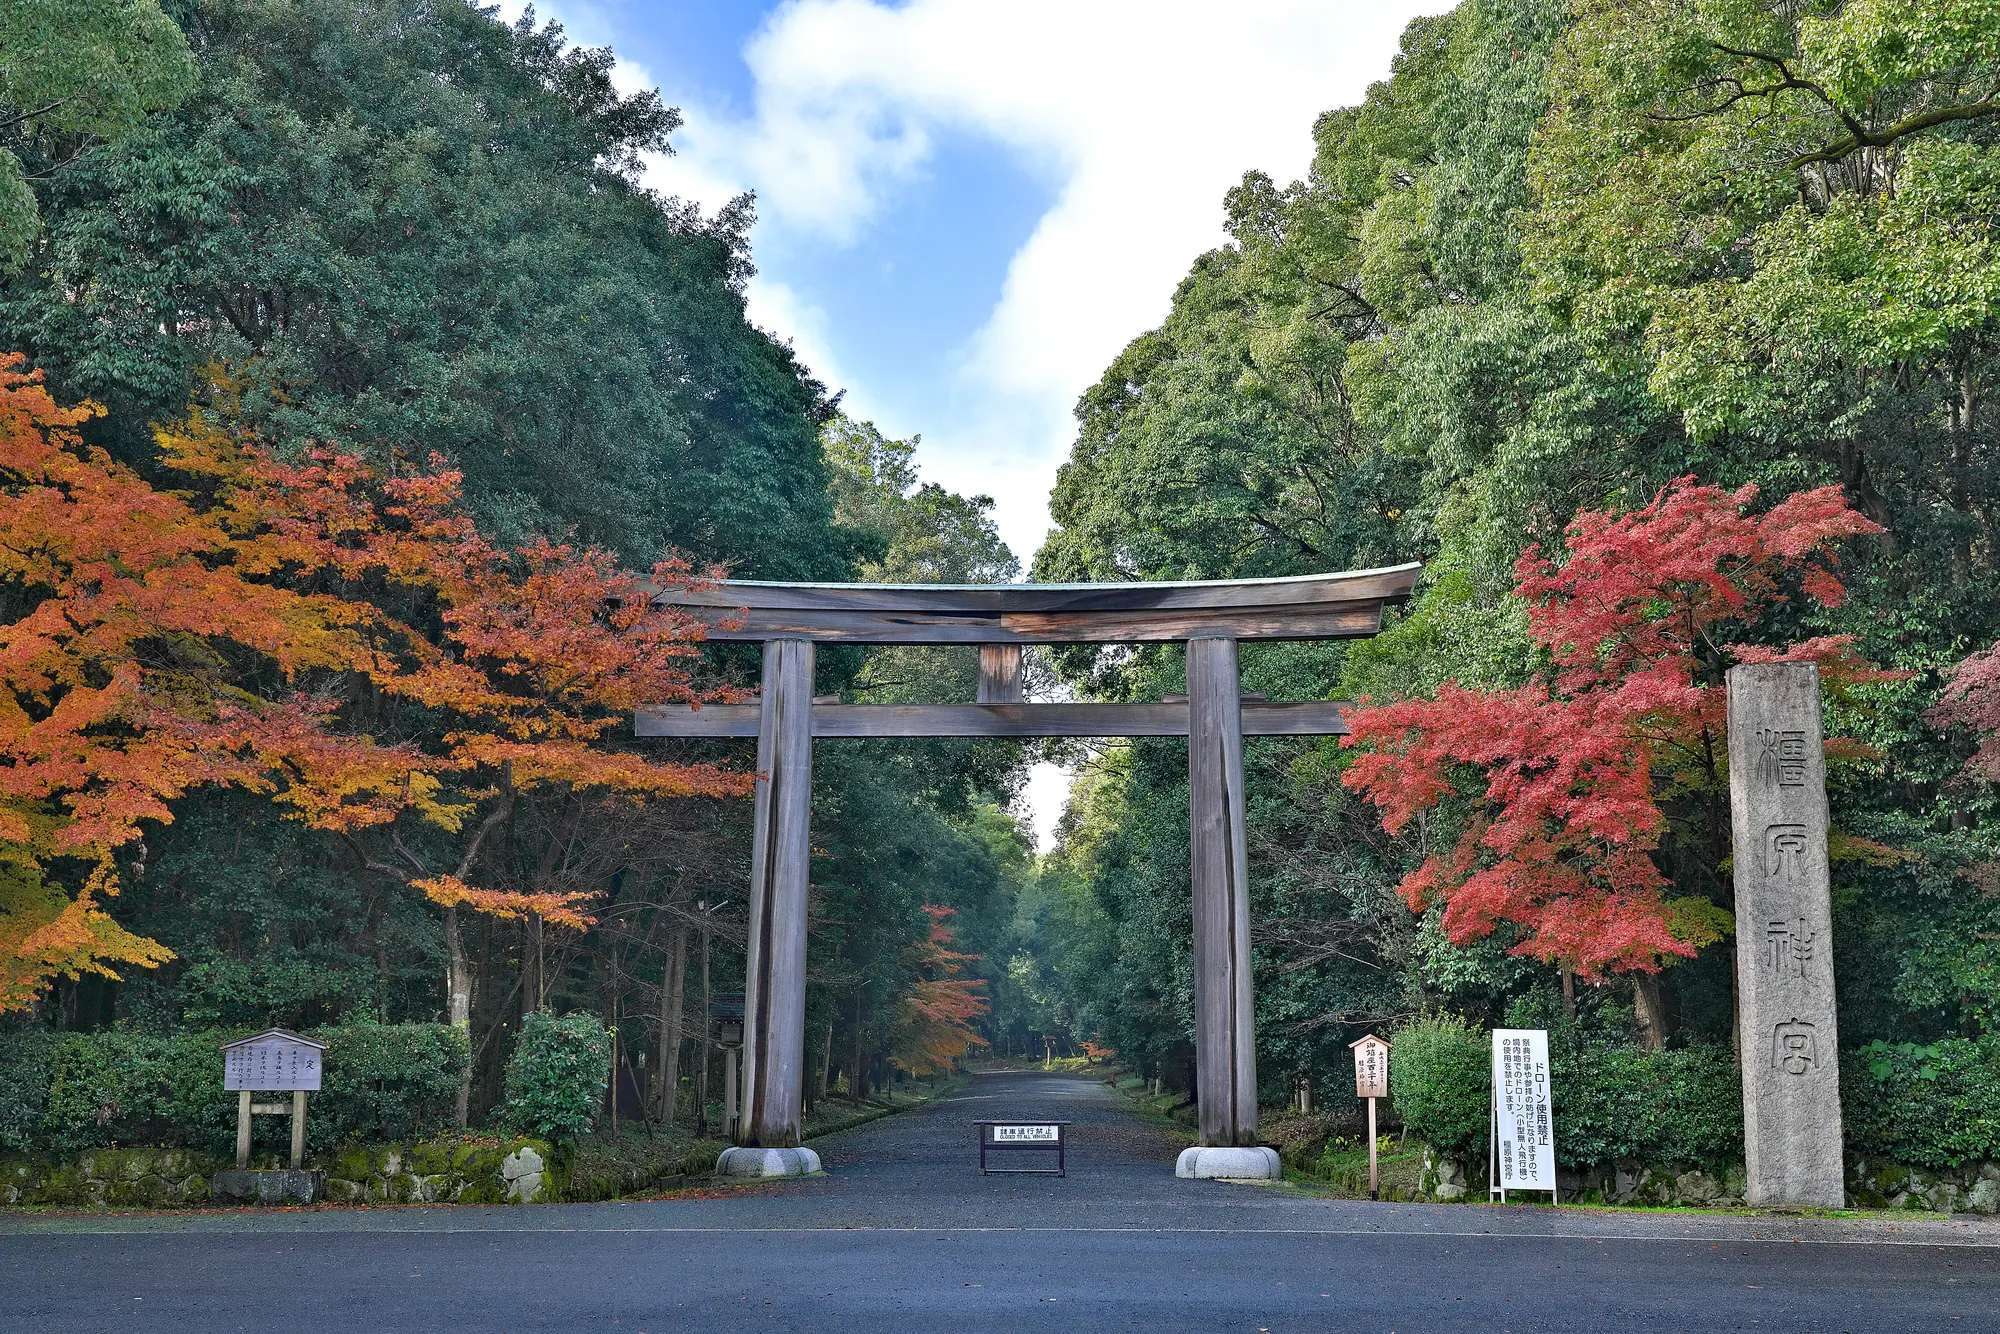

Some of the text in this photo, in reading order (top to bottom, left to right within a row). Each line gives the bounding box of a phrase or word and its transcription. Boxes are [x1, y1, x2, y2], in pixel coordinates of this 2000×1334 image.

[1757, 729, 1820, 1075] 橿原神宮
[305, 1059, 315, 1070] 定
[1502, 1038, 1515, 1115] の使用を禁止します。
[1535, 1062, 1549, 1146] ドローン使用禁止
[1522, 1038, 1538, 1182] 祭典行事や参拝の妨げになりますので、
[1503, 1140, 1512, 1180] 橿原神宮庁
